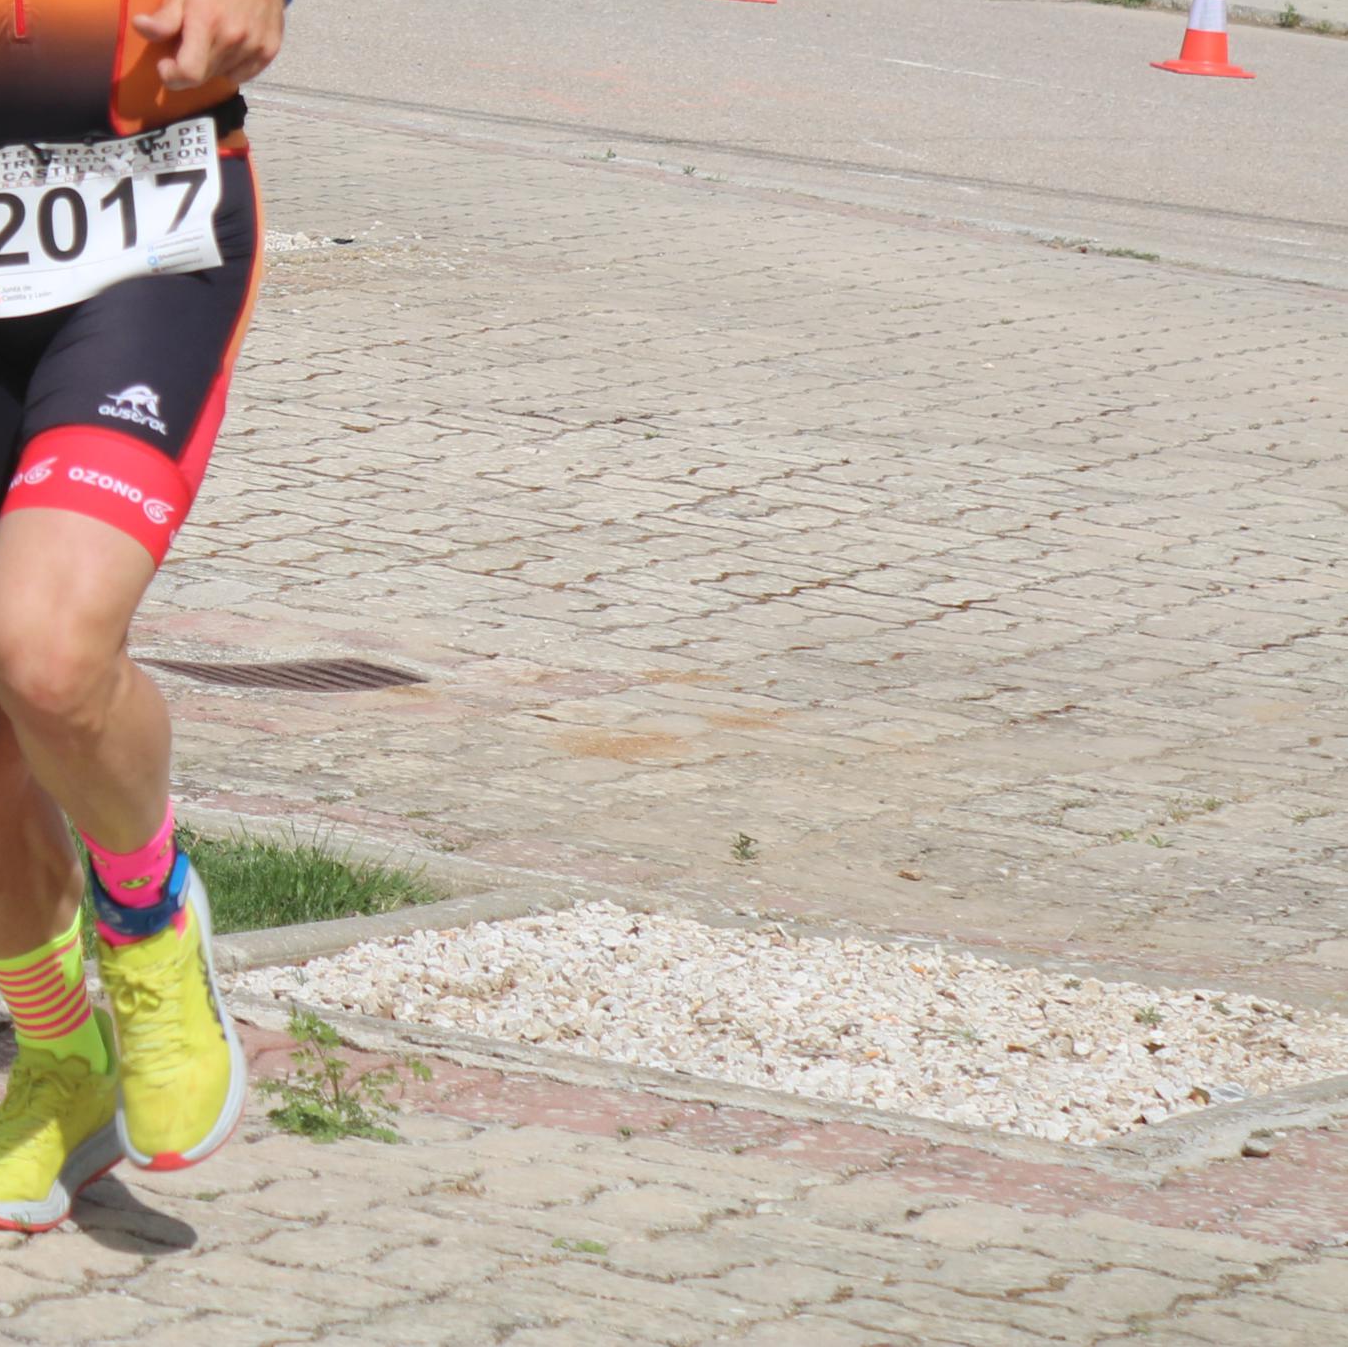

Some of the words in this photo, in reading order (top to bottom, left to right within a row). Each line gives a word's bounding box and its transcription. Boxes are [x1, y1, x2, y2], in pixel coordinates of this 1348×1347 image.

[1, 139, 147, 160] FEERACI
[178, 124, 207, 137] DE
[1, 154, 107, 170] TRITLON
[179, 135, 208, 148] DE
[1, 163, 117, 181] CASTILLA
[68, 467, 143, 503] OZONO
